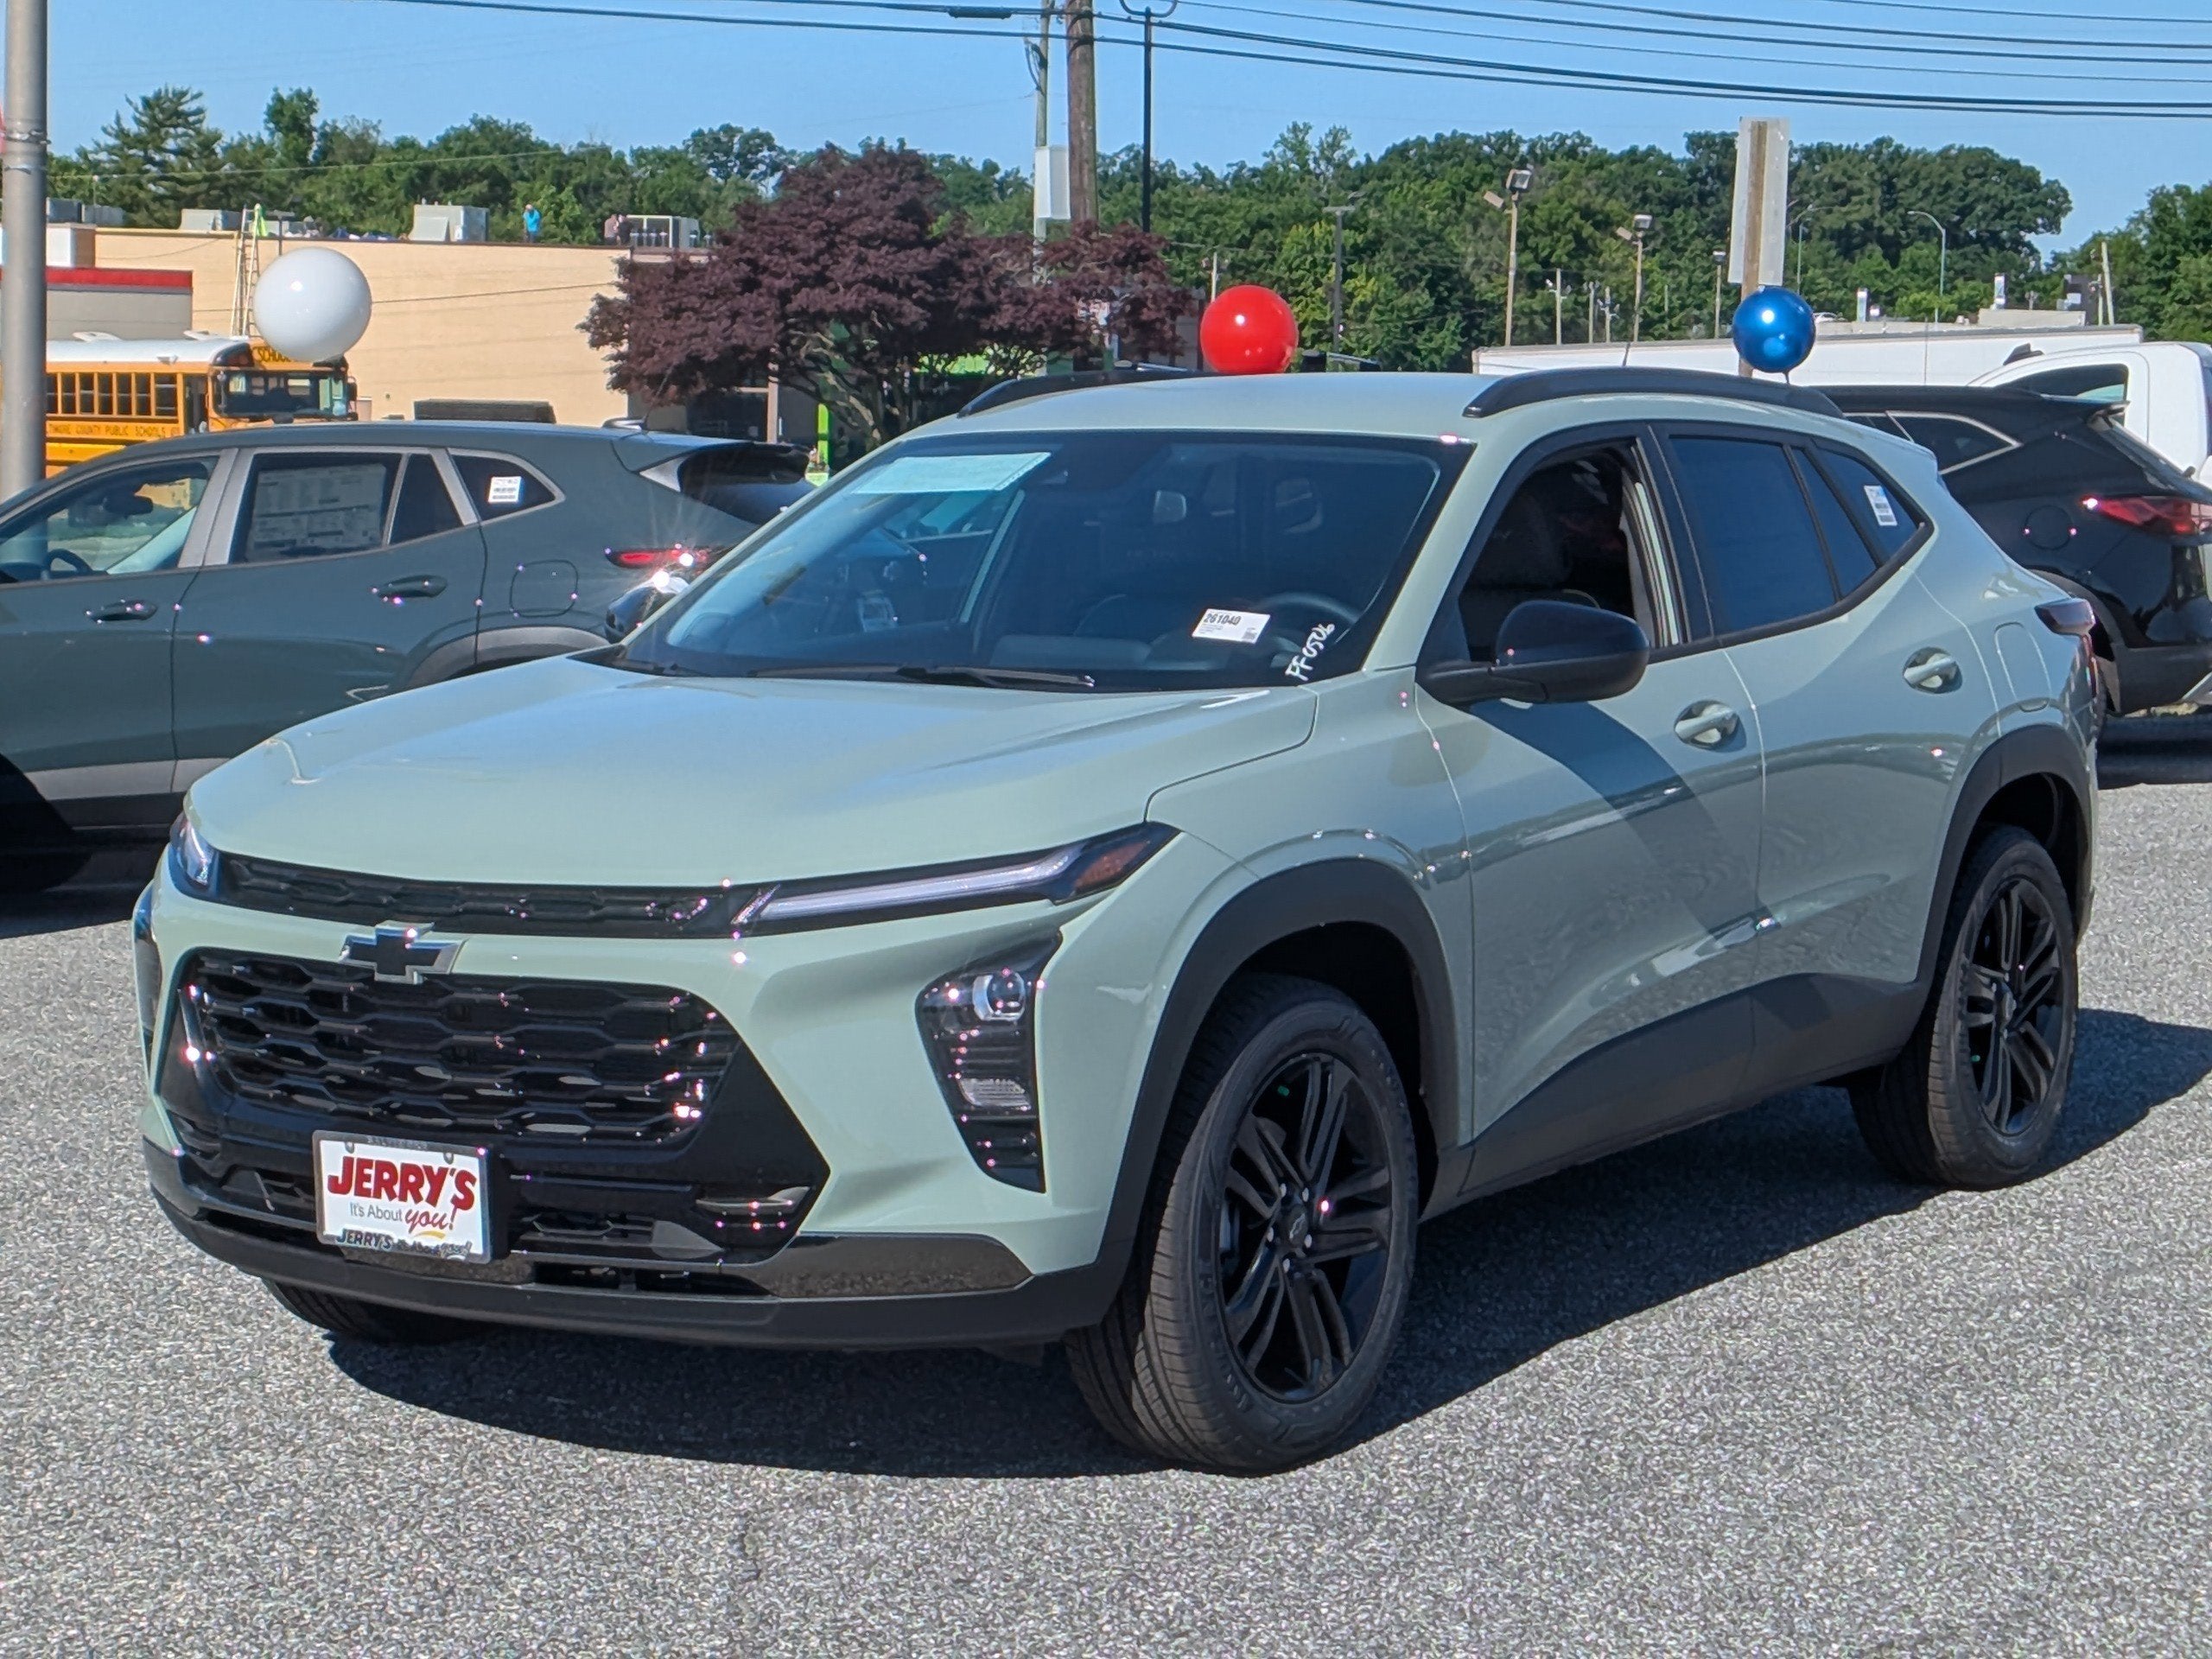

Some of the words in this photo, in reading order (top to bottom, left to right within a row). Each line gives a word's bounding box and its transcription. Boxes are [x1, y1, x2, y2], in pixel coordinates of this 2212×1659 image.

[105, 425, 129, 436] PUBLIC
[135, 426, 167, 438] SCHOOLS
[327, 1155, 477, 1211] JERRY'S
[349, 1202, 365, 1217] It's
[367, 1206, 403, 1223] About
[404, 1208, 458, 1235] you!
[335, 1228, 394, 1250] JERRY'S
